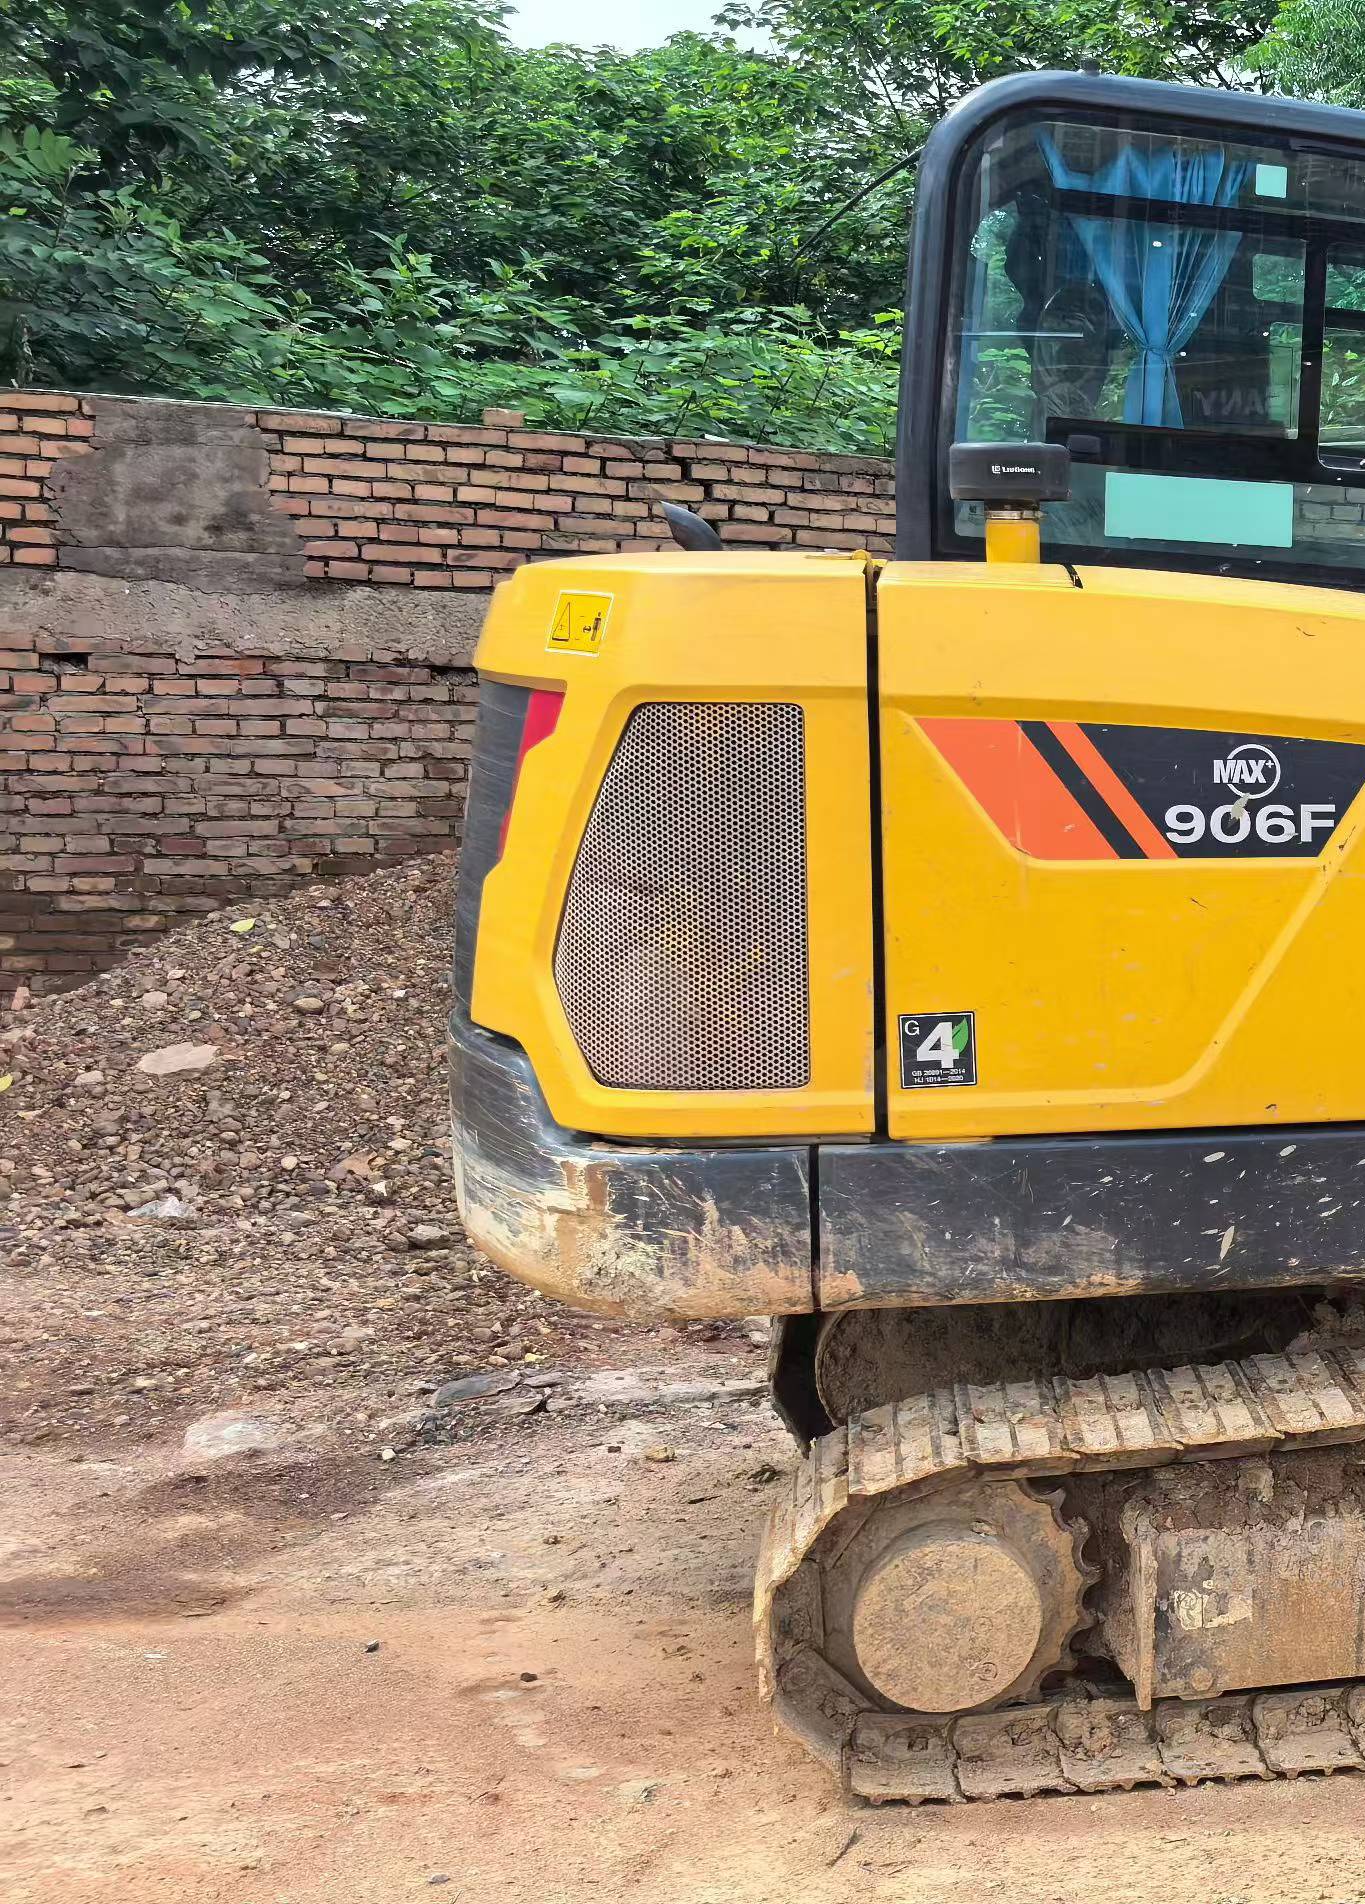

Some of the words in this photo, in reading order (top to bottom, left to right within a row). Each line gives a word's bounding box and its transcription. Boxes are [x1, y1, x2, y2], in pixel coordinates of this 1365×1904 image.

[1163, 803, 1337, 844] 906F
[904, 1019, 920, 1036] G
[916, 1021, 960, 1069] 4
